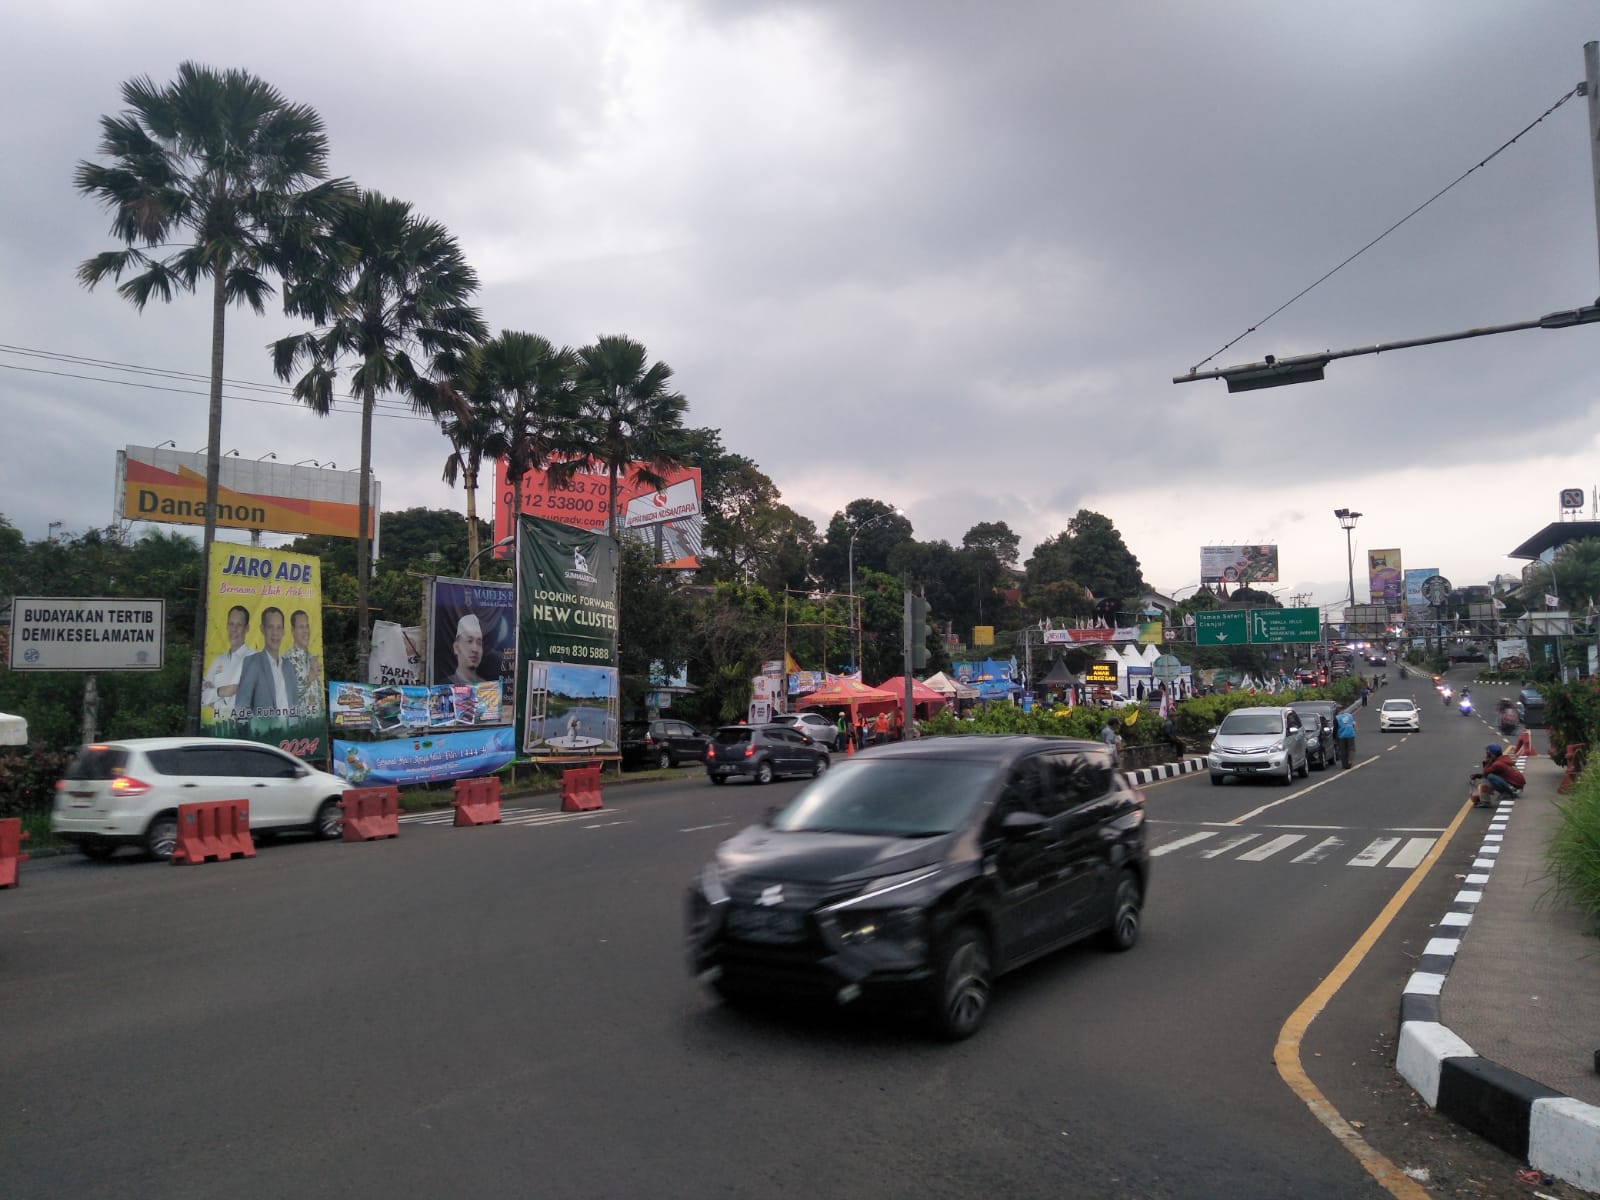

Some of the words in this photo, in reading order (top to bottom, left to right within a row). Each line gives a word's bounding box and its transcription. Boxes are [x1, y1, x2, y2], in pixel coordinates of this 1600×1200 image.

[590, 483, 625, 496] 707
[504, 492, 542, 507] 012
[547, 496, 594, 512] 53800
[657, 503, 696, 518] NUSANTARA
[222, 554, 272, 579] JARO
[275, 561, 312, 584] ADE
[534, 589, 577, 604] LOOKING
[24, 609, 104, 622] BUDAYAKAN
[107, 610, 154, 623] TERTIB
[533, 604, 571, 622] NEW
[549, 645, 570, 656] (0251)
[572, 645, 588, 658] 830
[589, 646, 609, 659] 5888
[231, 708, 252, 719] Ade
